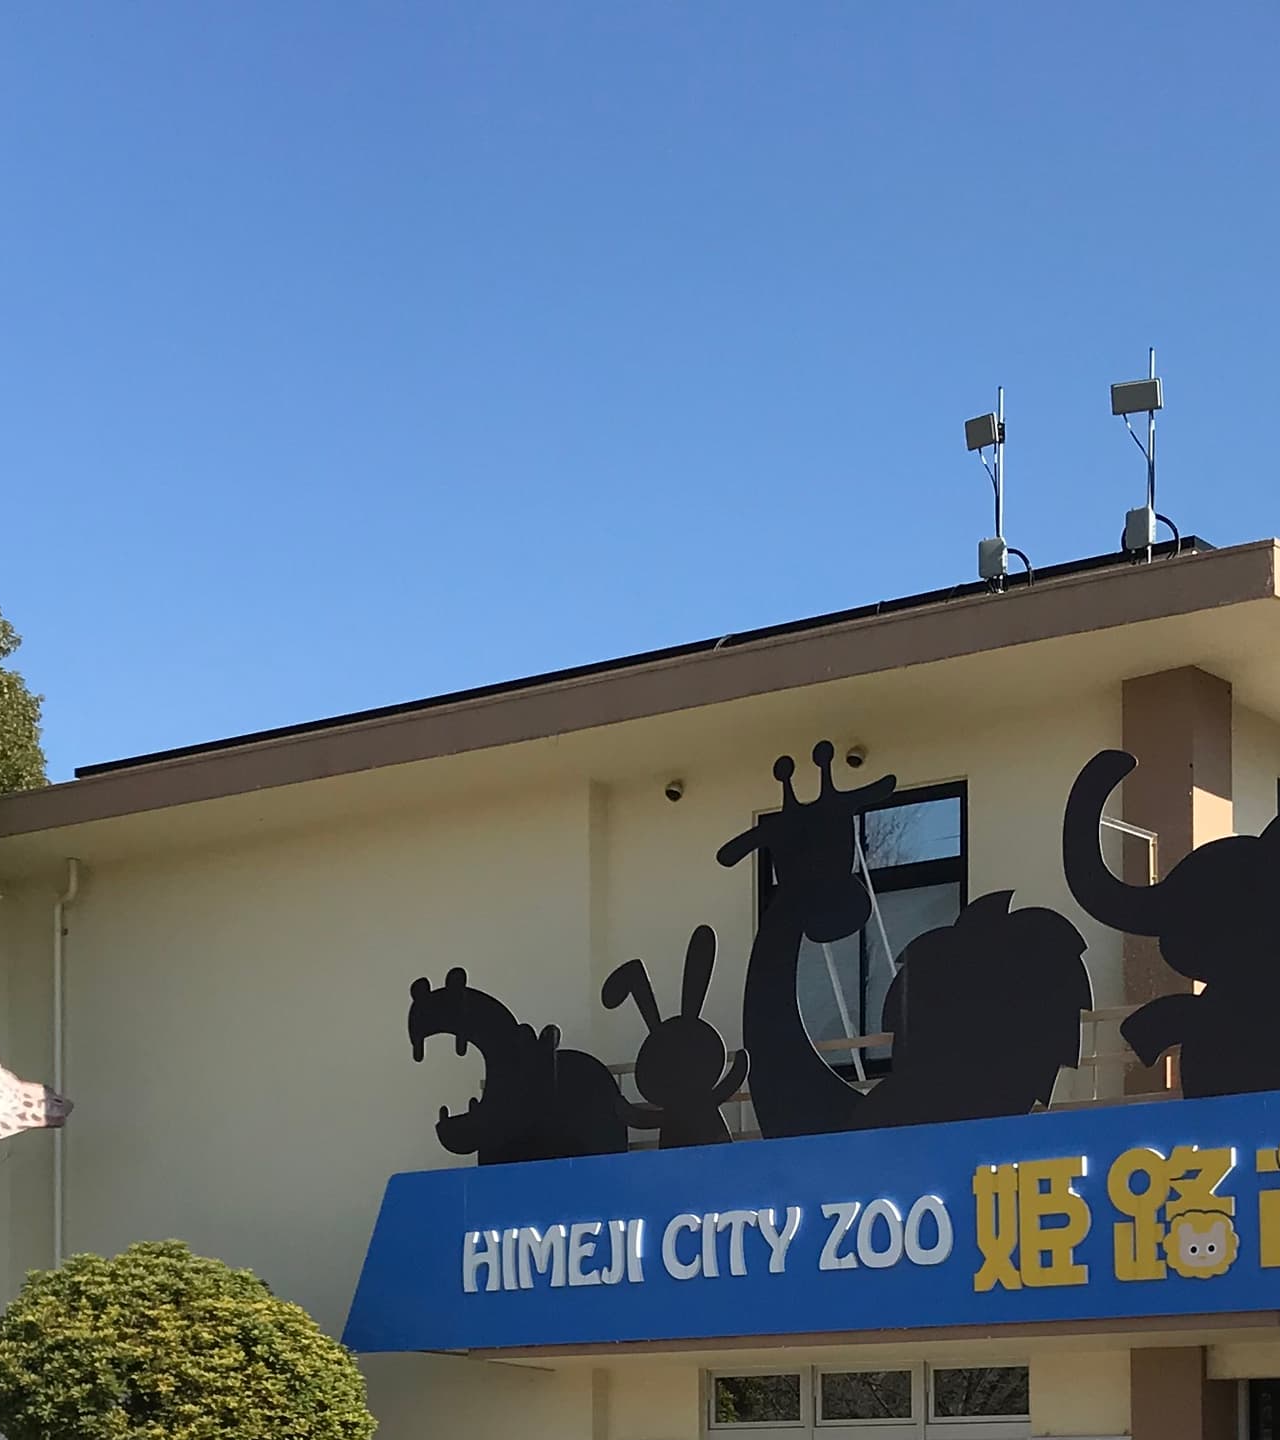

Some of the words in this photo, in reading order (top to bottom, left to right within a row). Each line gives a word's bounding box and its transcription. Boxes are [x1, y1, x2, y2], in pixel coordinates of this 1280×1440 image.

[463, 1219, 644, 1292] HIMEJI
[662, 1206, 801, 1281] CITY
[820, 1195, 954, 1270] ZOO
